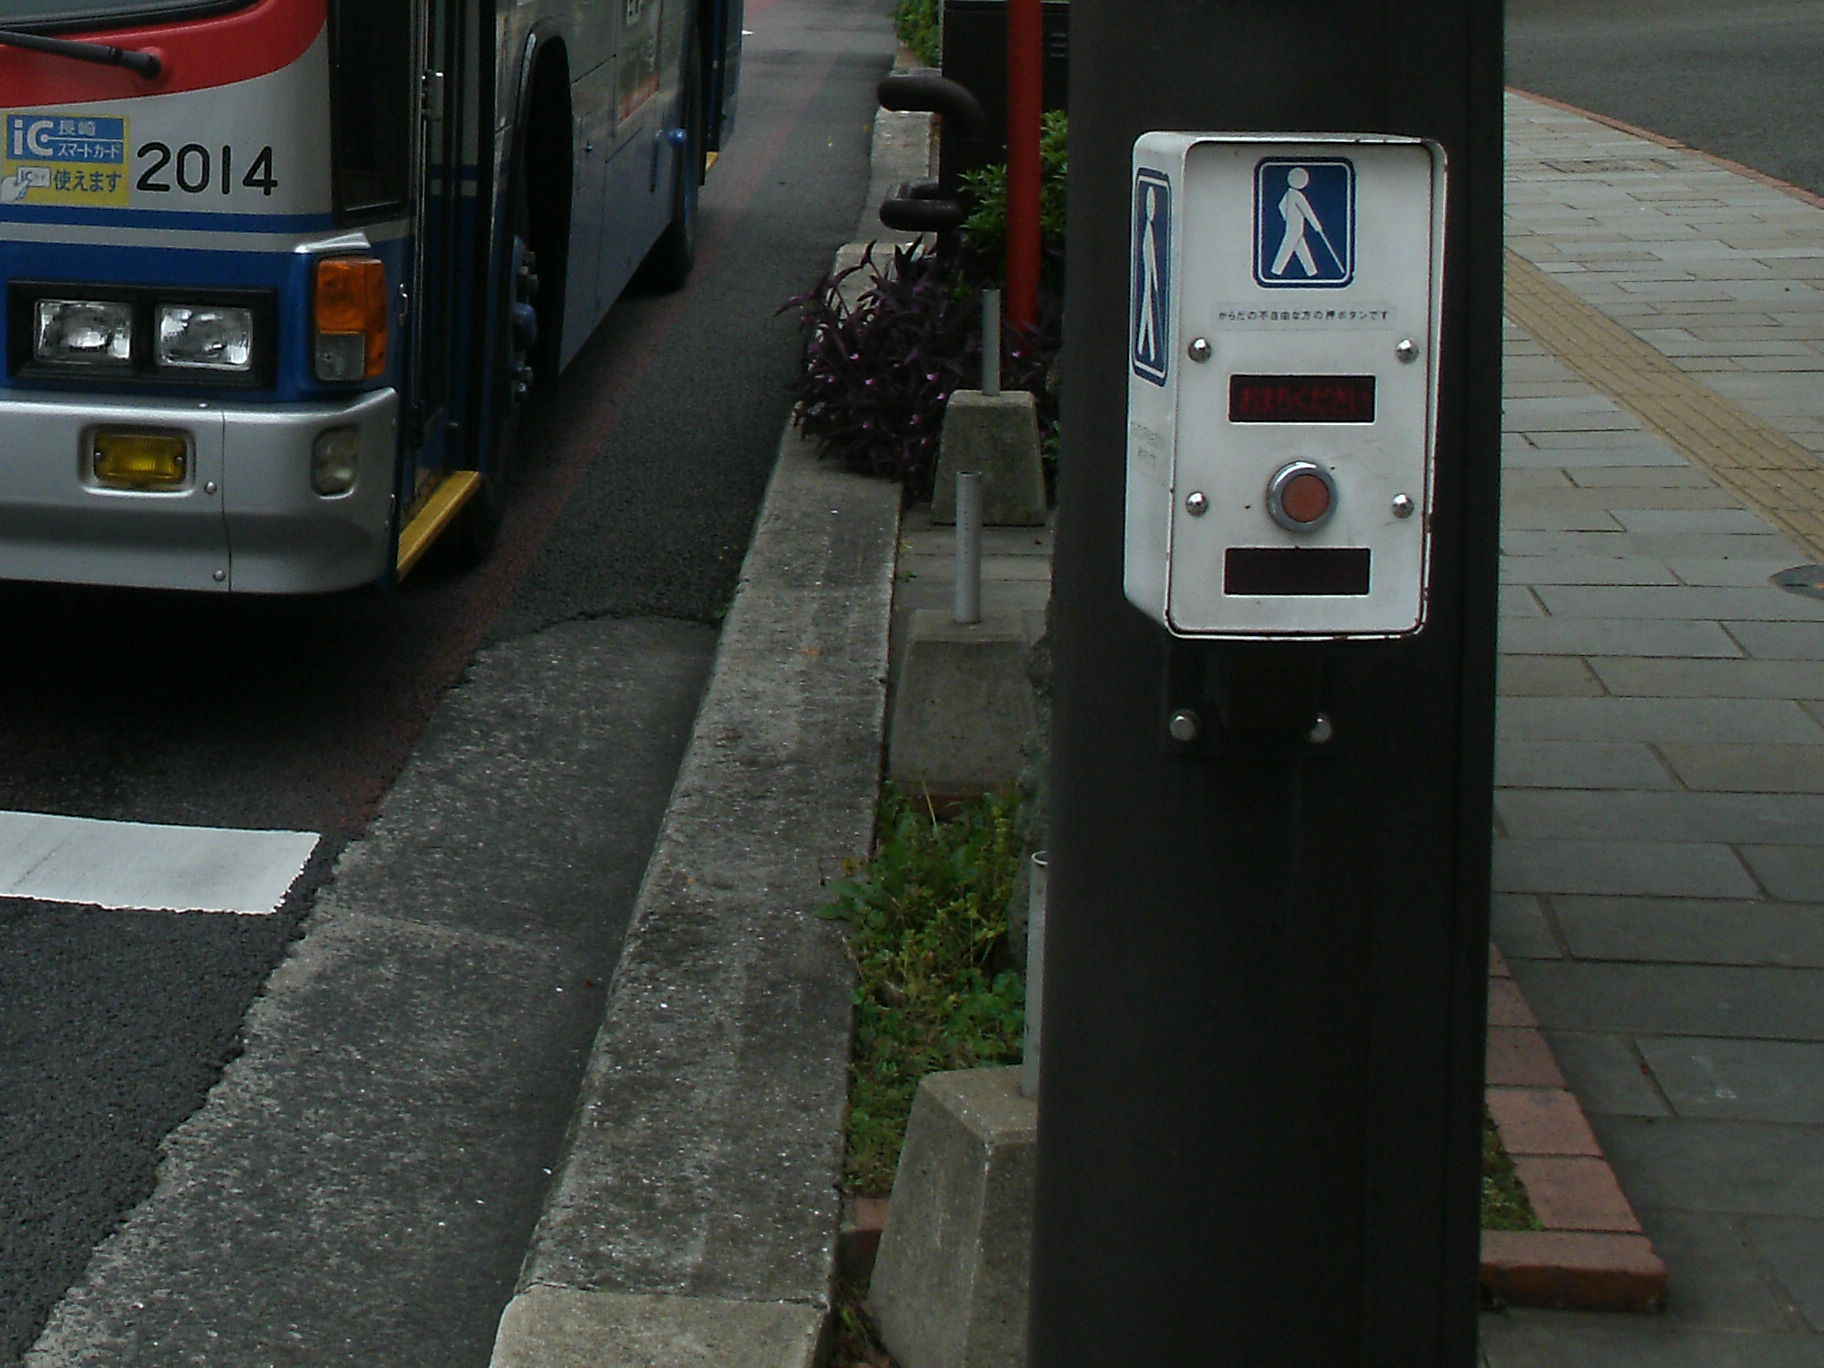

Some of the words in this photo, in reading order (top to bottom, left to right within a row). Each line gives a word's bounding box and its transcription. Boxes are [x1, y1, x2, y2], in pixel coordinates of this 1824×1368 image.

[58, 119, 96, 137] 長崎
[57, 141, 122, 160] スマートカード
[136, 141, 279, 197] 2014
[53, 170, 123, 193] 使えます
